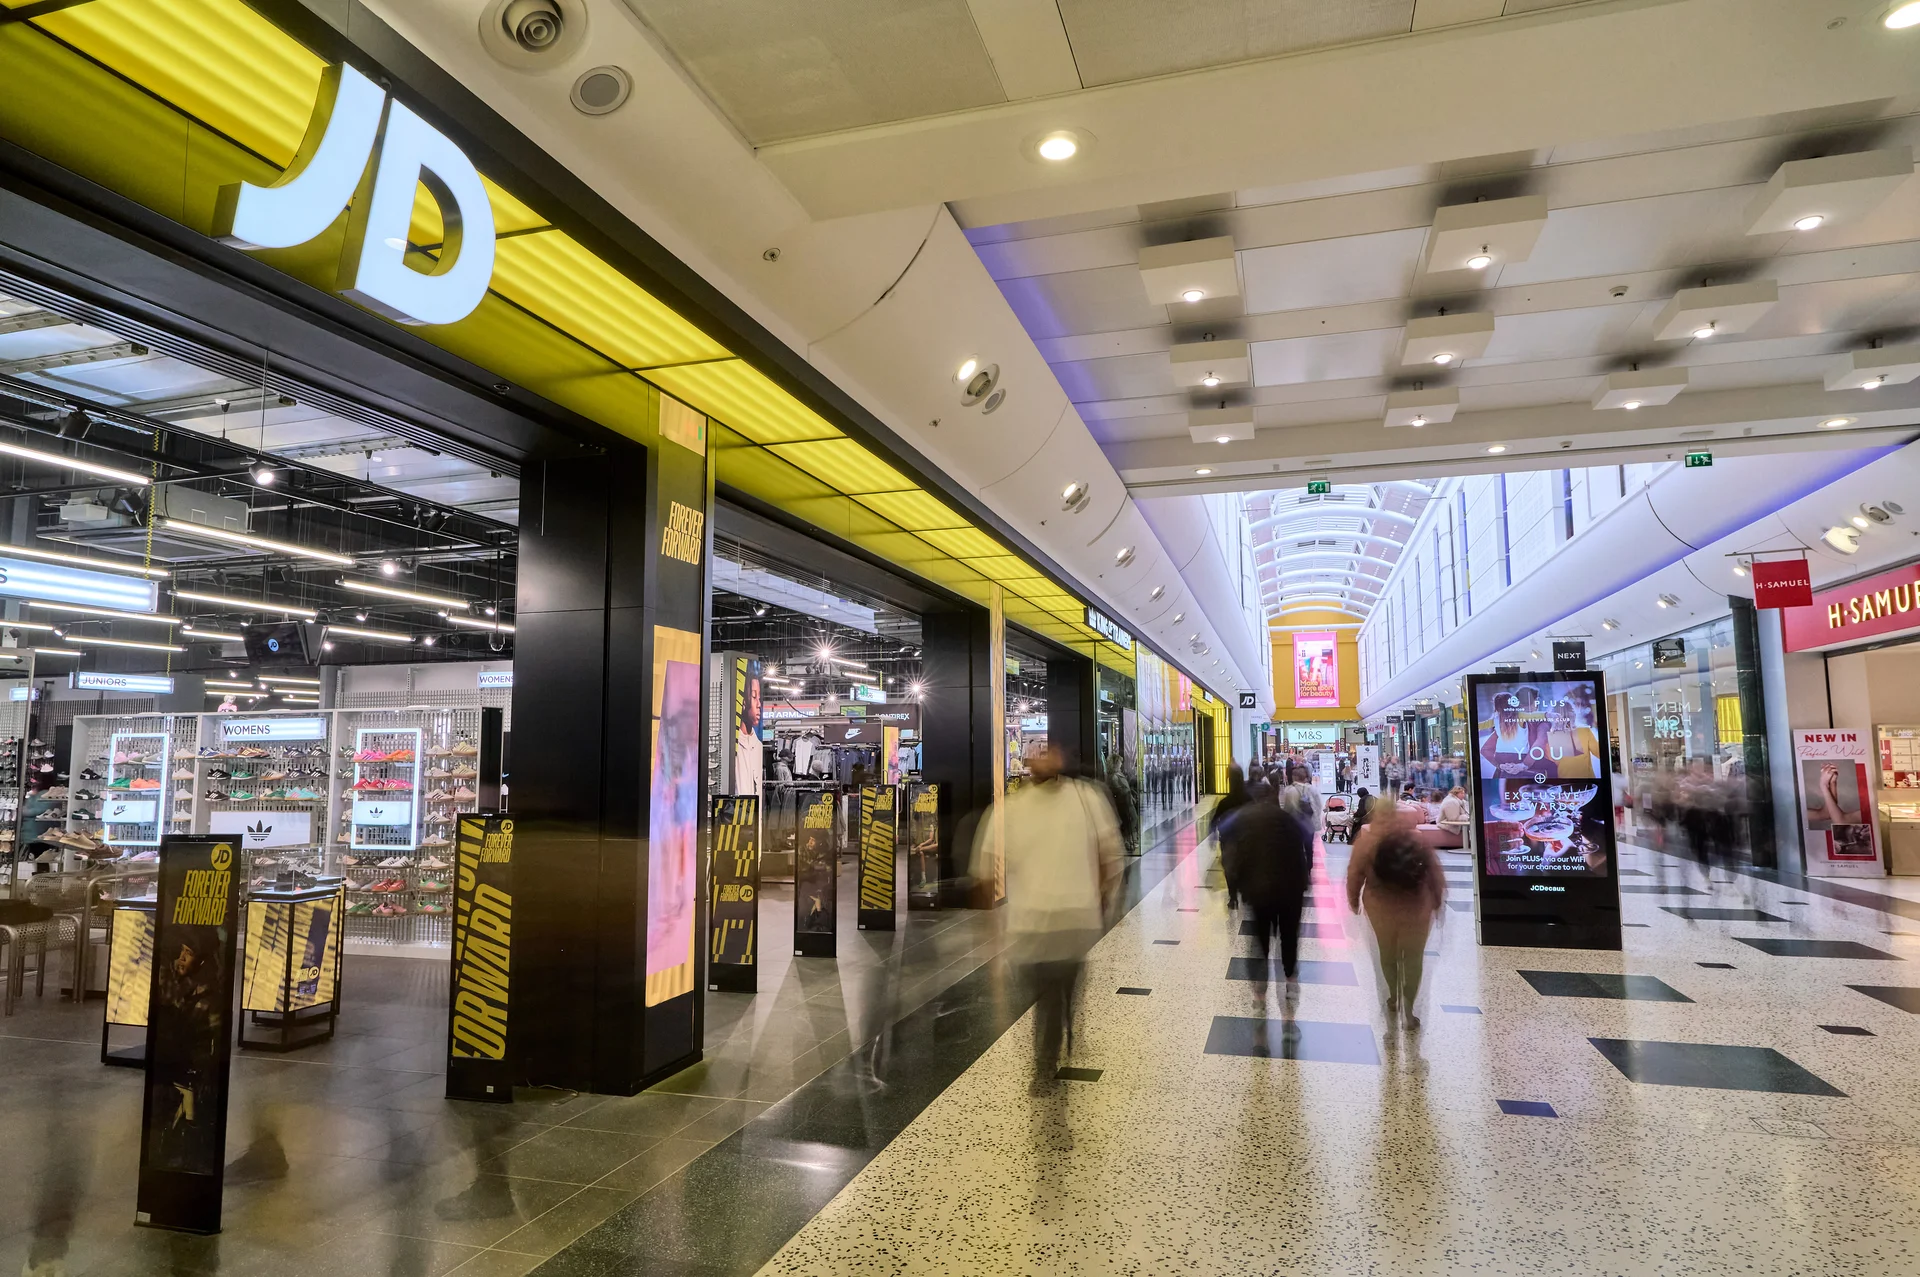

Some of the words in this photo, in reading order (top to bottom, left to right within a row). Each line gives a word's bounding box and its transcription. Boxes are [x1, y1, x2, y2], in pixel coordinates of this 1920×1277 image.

[230, 60, 496, 325] JD
[668, 500, 704, 540] FOREVER
[661, 526, 702, 566] FORWARD
[82, 676, 127, 687] JUNIORS
[1310, 690, 1333, 698] beauty
[1241, 696, 1255, 706] JD
[1534, 699, 1566, 708] PLUS
[223, 724, 271, 736] WOMENS
[1297, 730, 1323, 740] M&S
[1804, 733, 1837, 743] NEW
[1841, 733, 1857, 742] IN
[1513, 746, 1563, 761] YOU
[1504, 791, 1580, 801] EXCLUSIVE
[1509, 802, 1576, 811] REWARDS
[485, 833, 514, 849] FOREVER
[480, 847, 512, 863] FORWARD
[1519, 864, 1534, 872] your
[182, 869, 232, 899] FOREVER
[1529, 884, 1566, 892] JCDecaux
[172, 896, 228, 926] FORWARD
